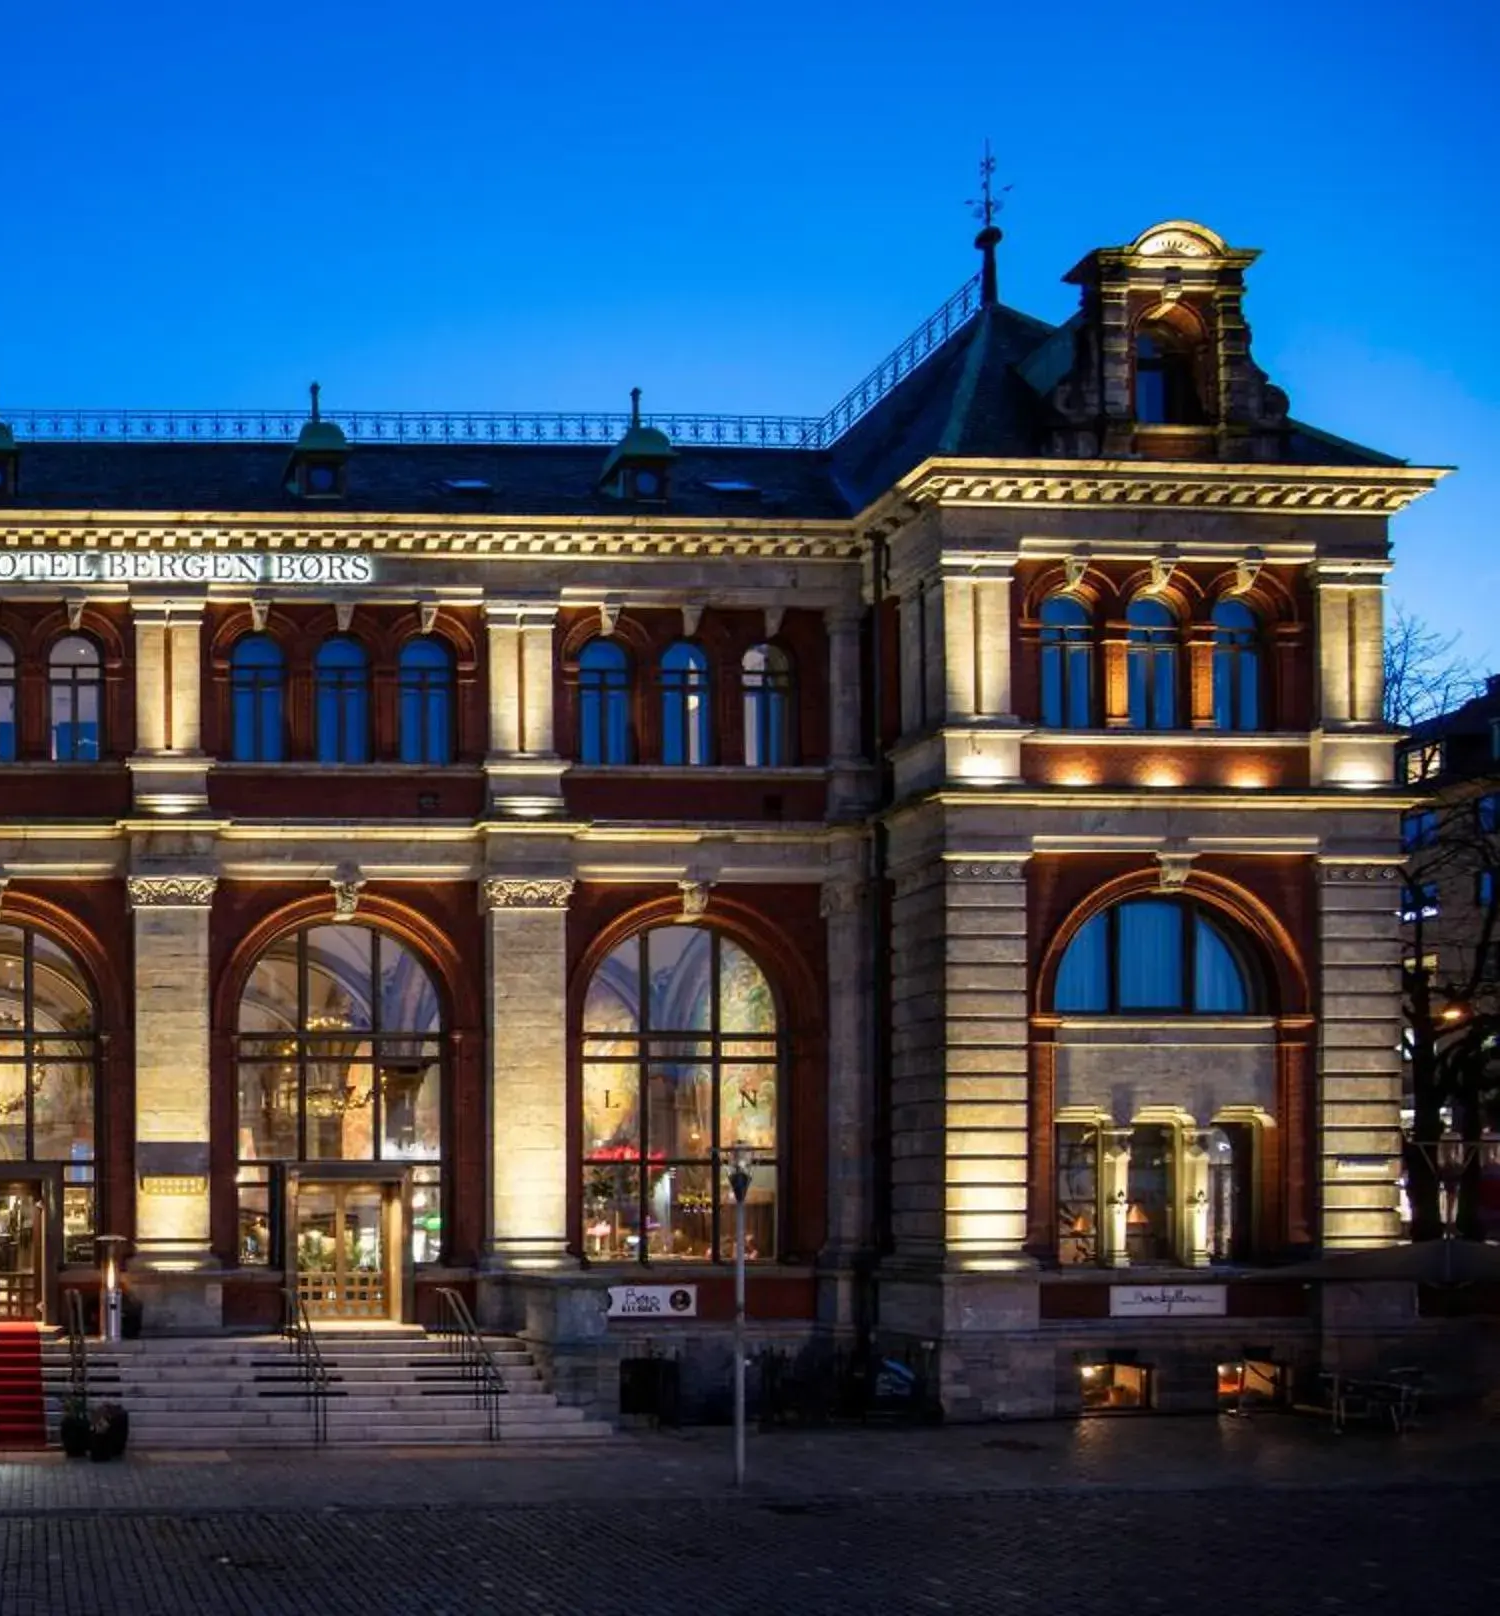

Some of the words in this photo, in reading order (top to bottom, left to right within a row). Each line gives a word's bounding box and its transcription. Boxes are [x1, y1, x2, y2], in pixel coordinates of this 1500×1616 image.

[104, 553, 260, 580] BERGEN
[272, 554, 371, 580] BØRS
[604, 1089, 621, 1109] L
[738, 1089, 759, 1109] N
